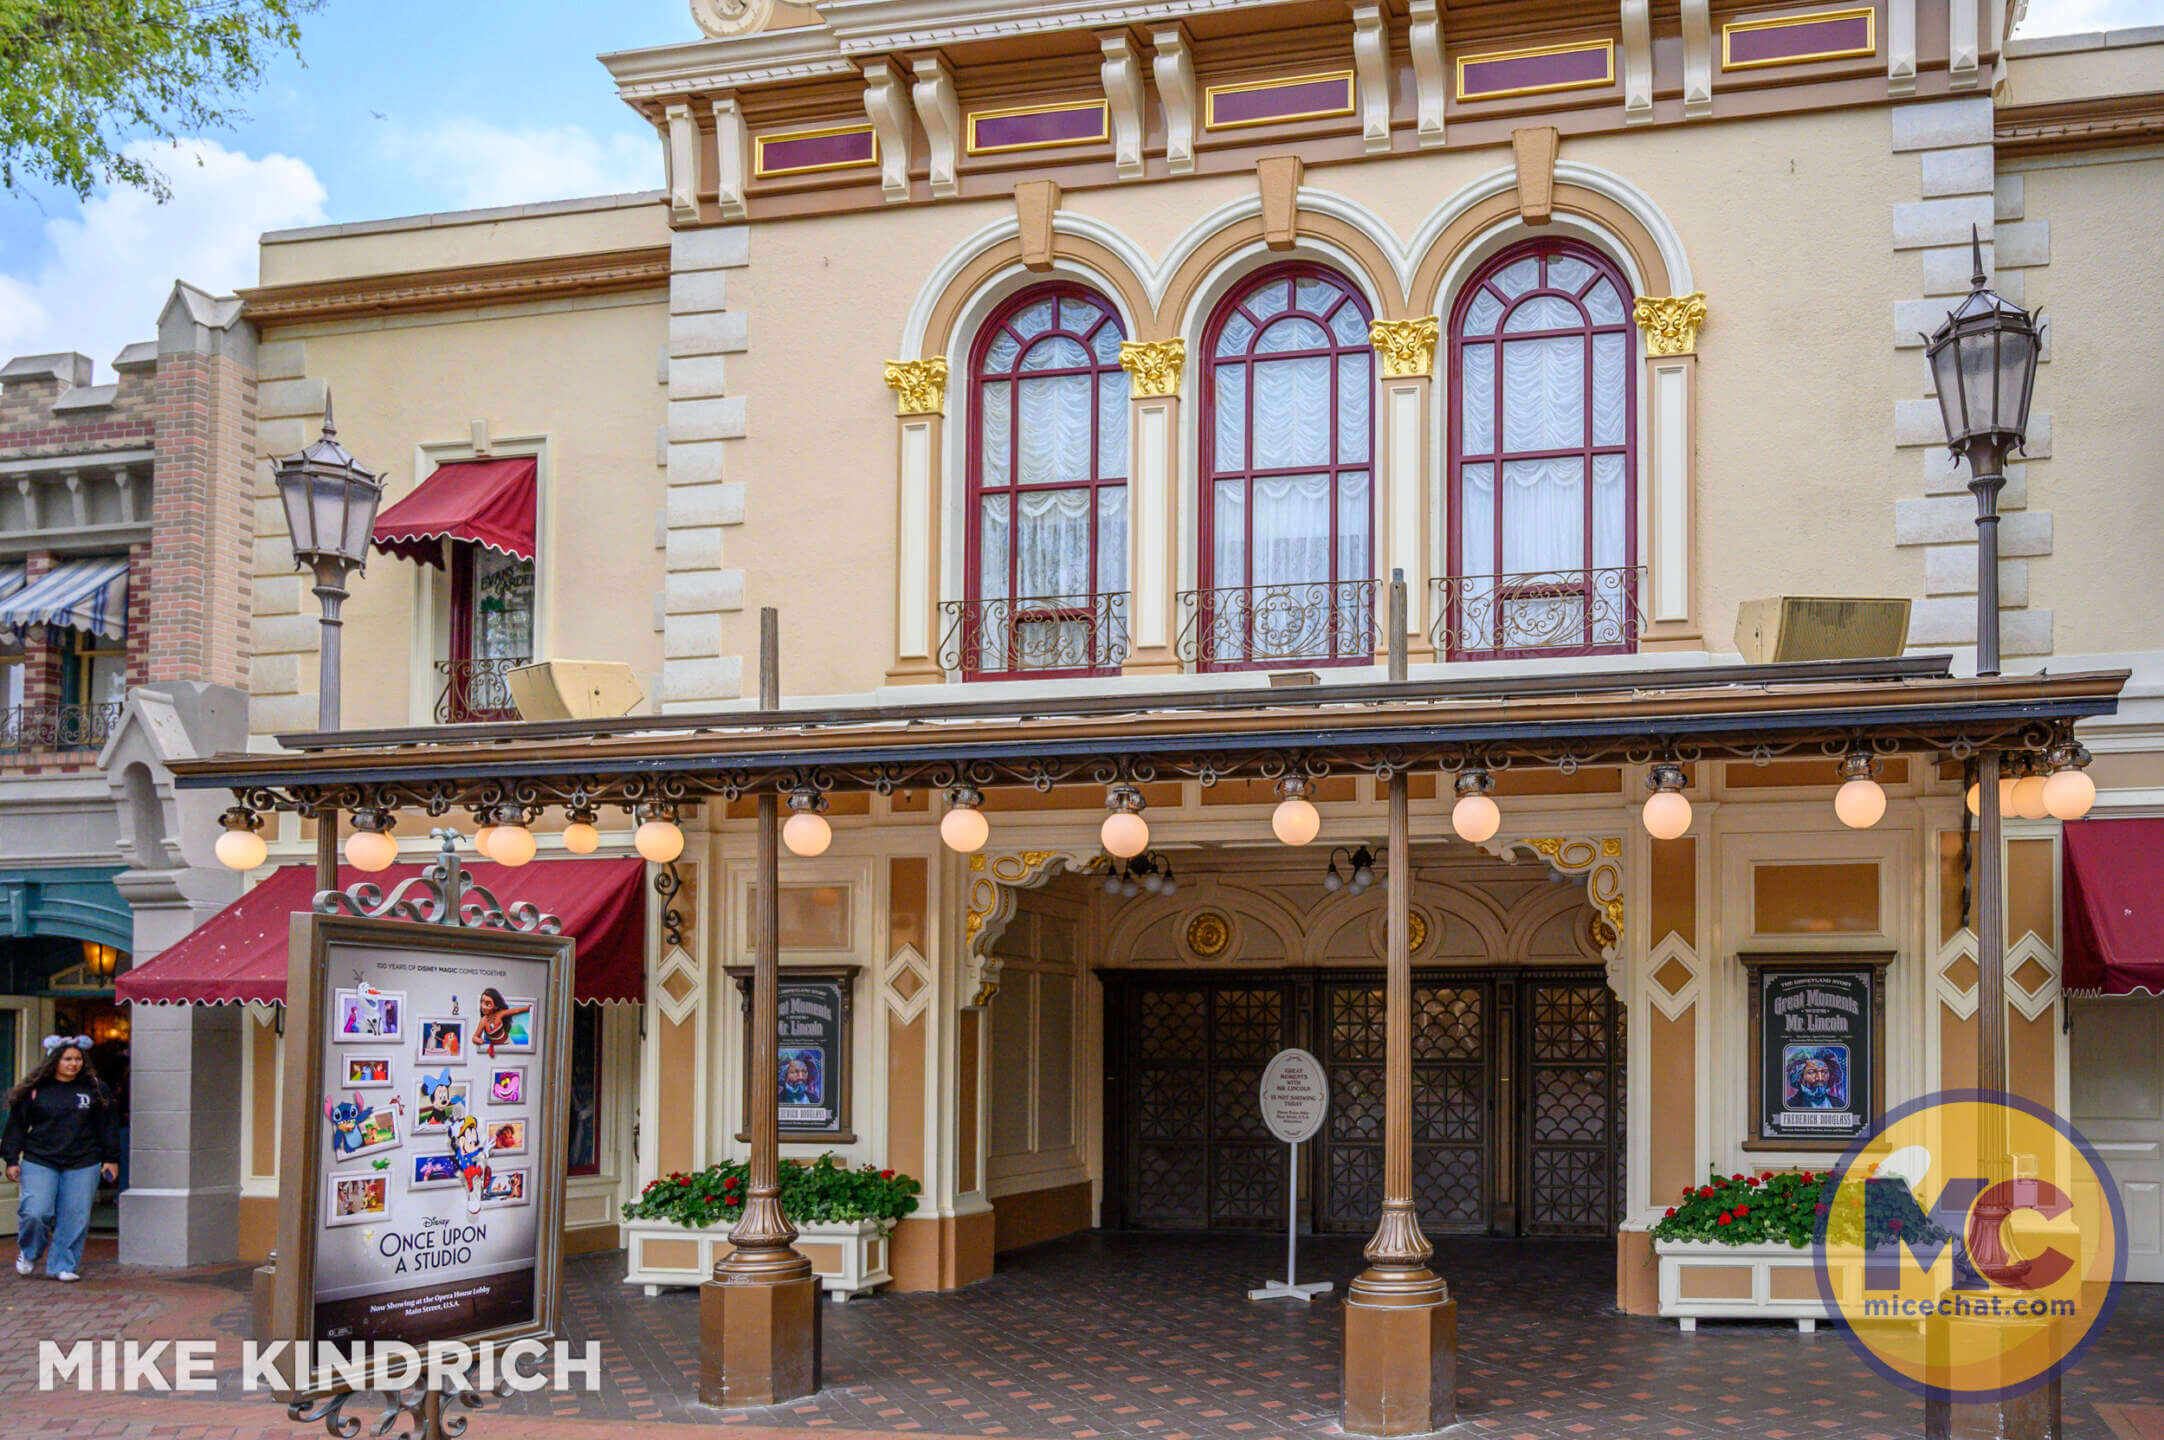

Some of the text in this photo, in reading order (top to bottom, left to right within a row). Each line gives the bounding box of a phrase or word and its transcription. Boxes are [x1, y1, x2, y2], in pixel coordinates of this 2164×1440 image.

[439, 966, 458, 974] MAGIC
[459, 967, 478, 975] COMES
[480, 968, 506, 977] TOGETHER
[790, 998, 832, 1021] Moments
[1774, 989, 1859, 1015] Great Moments
[790, 1020, 824, 1036] Lincoln
[1785, 1014, 1848, 1032] Mr. Lincoln
[1783, 1114, 1851, 1125] FREDERICK DOUGLASS
[421, 1216, 450, 1228] Disney
[380, 1224, 487, 1257] ONCE UPON
[395, 1246, 471, 1274] A STUDIO
[370, 1304, 386, 1313] Now
[386, 1299, 415, 1310] Showing
[423, 1295, 434, 1303] the
[434, 1293, 454, 1302] Opera
[454, 1289, 473, 1298] House
[473, 1285, 491, 1296] Lobby
[405, 1308, 421, 1317] Main
[422, 1304, 443, 1313] Street,
